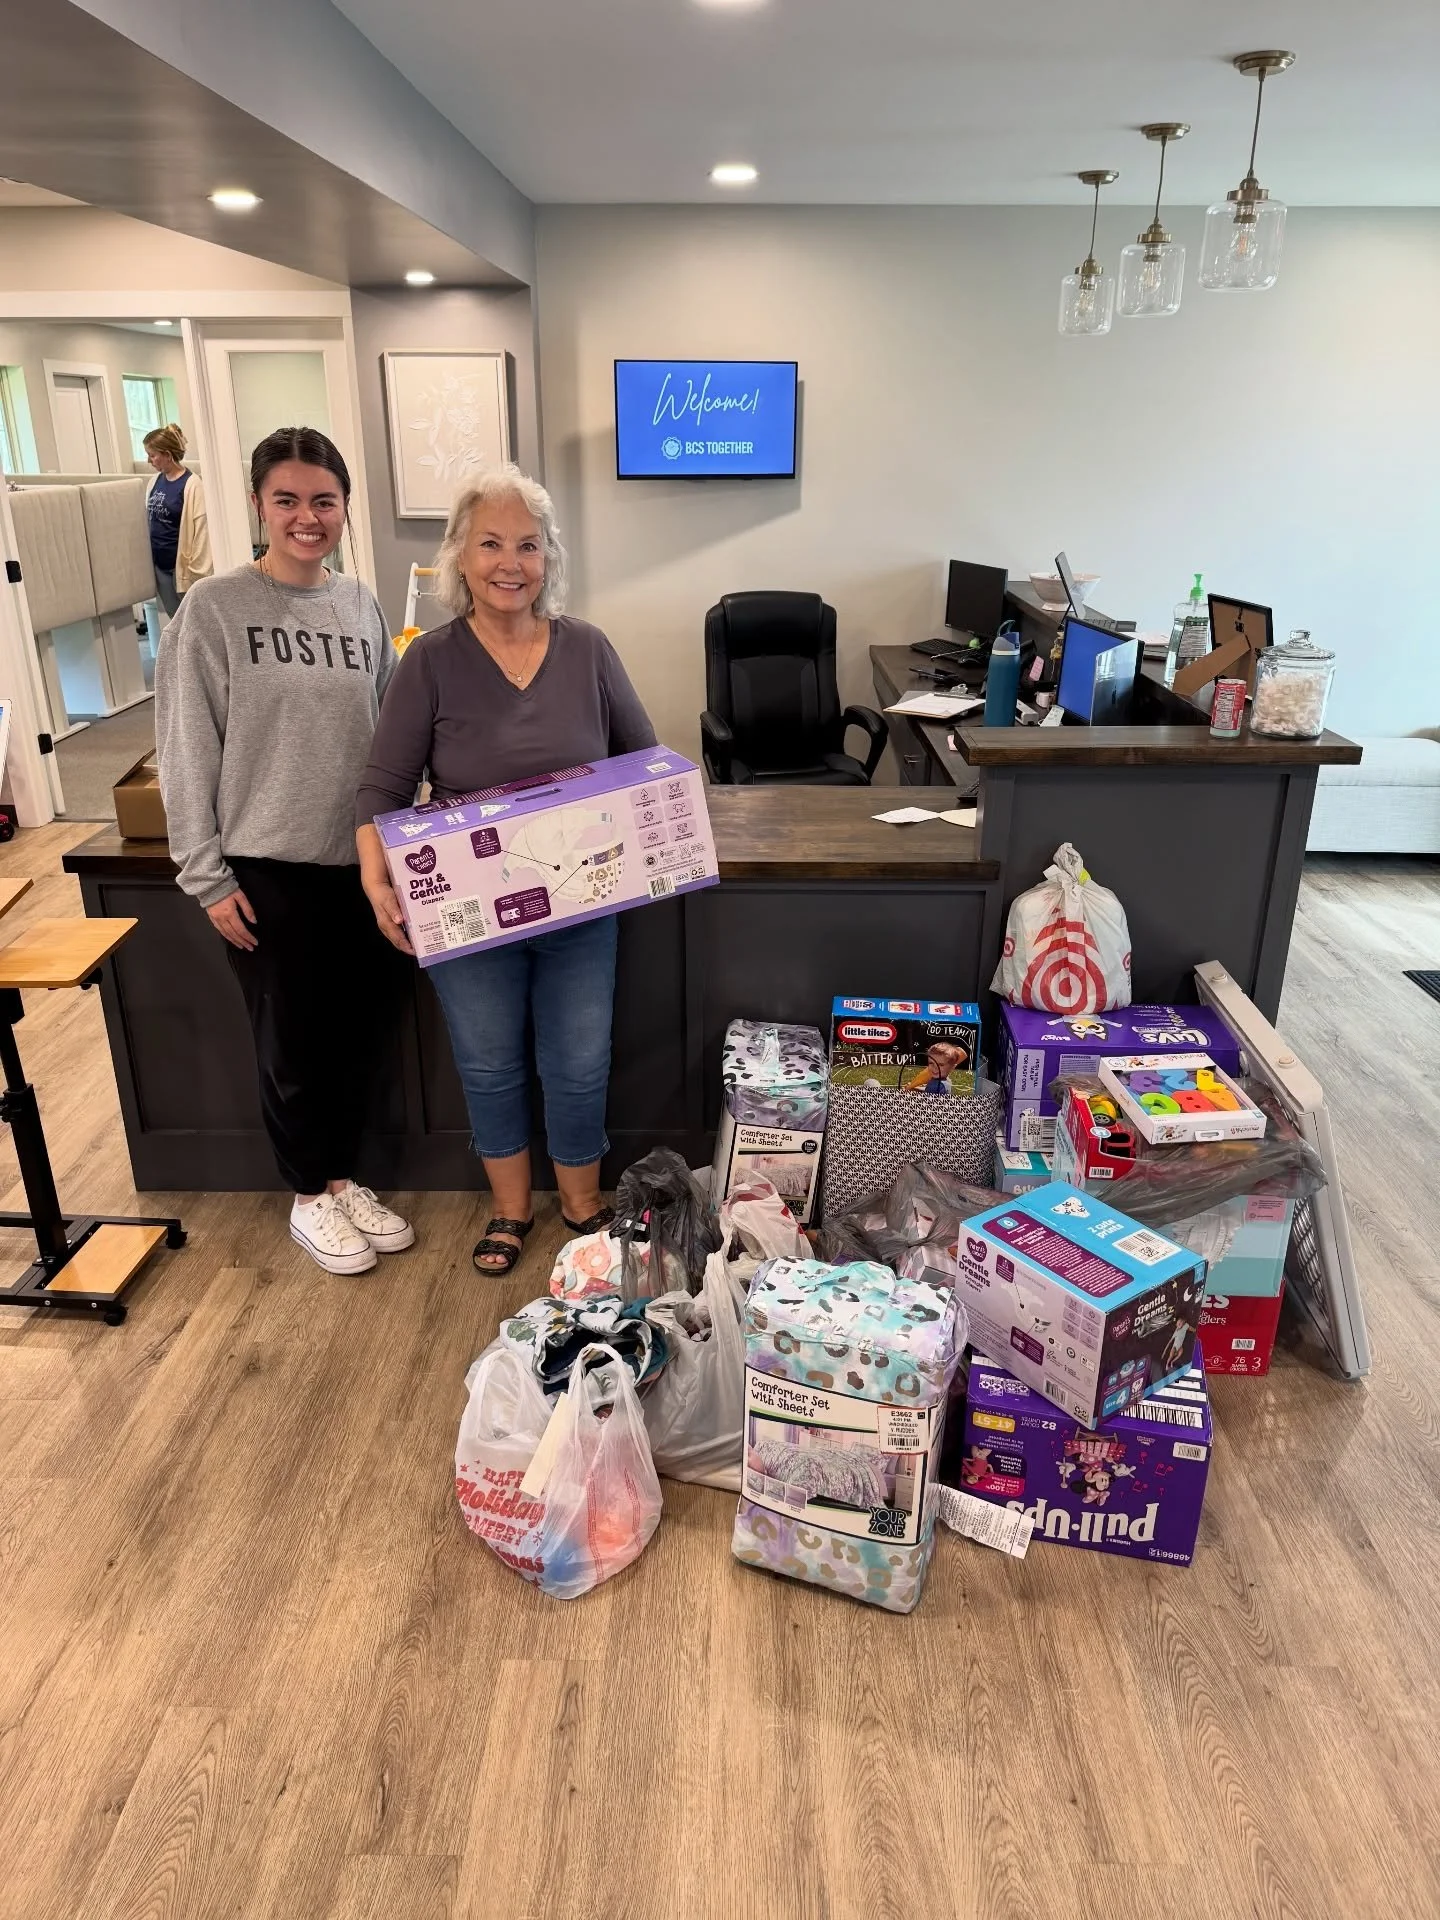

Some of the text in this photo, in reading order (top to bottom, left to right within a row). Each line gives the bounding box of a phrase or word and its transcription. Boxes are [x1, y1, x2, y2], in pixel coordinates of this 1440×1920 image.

[652, 373, 760, 426] Welcome!
[685, 441, 754, 455] BCS TOGETHER
[246, 626, 374, 676] FOSTER
[409, 872, 446, 890] Dry &
[409, 883, 452, 901] Gentle
[421, 895, 445, 906] Diapers
[844, 1026, 891, 1038] little tikes
[929, 1025, 969, 1037] GO TEAM!
[850, 1053, 894, 1068] BATTER
[740, 1129, 793, 1142] Comforter Set
[758, 1139, 783, 1147] Sheets
[958, 1261, 991, 1287] Dreams
[961, 1254, 989, 1277] Gentle
[1137, 1293, 1166, 1315] Gentle
[1133, 1303, 1168, 1327] Dreams
[1235, 1356, 1262, 1369] 76 3
[751, 1376, 831, 1411] Comforter Set
[1115, 1389, 1127, 1404] 4
[777, 1395, 815, 1417] Sheets
[1041, 1420, 1057, 1431] 82
[870, 1507, 906, 1525] YOUR
[473, 1514, 529, 1546] MERRY
[869, 1520, 904, 1537] ZONE
